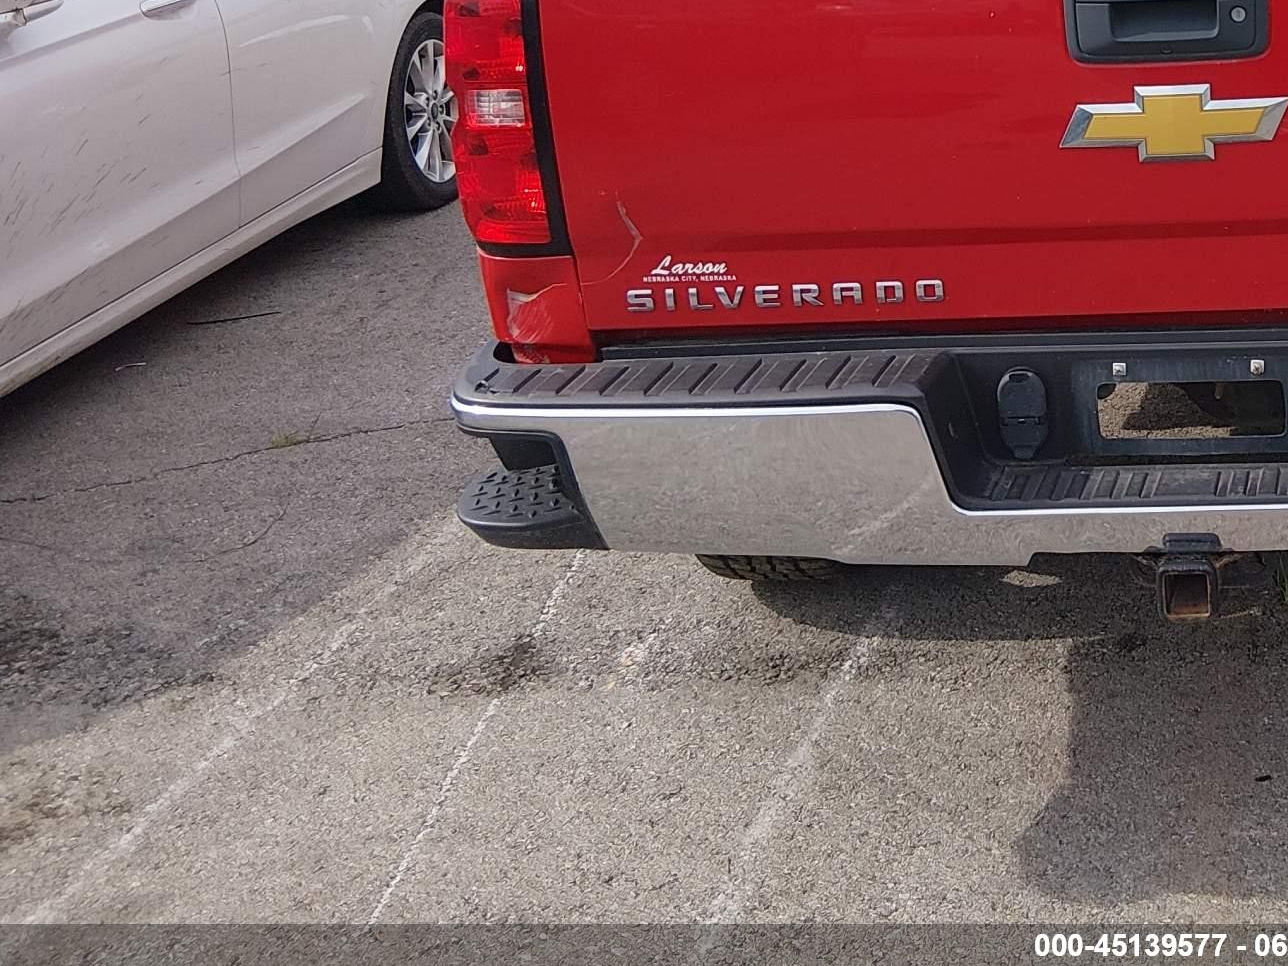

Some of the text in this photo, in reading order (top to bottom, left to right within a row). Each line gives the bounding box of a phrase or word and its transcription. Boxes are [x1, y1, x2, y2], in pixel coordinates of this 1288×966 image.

[650, 255, 728, 274] Larson
[642, 275, 680, 283] NEBRASKA
[700, 274, 737, 282] NEBRASKA
[626, 279, 945, 312] SILVERADO
